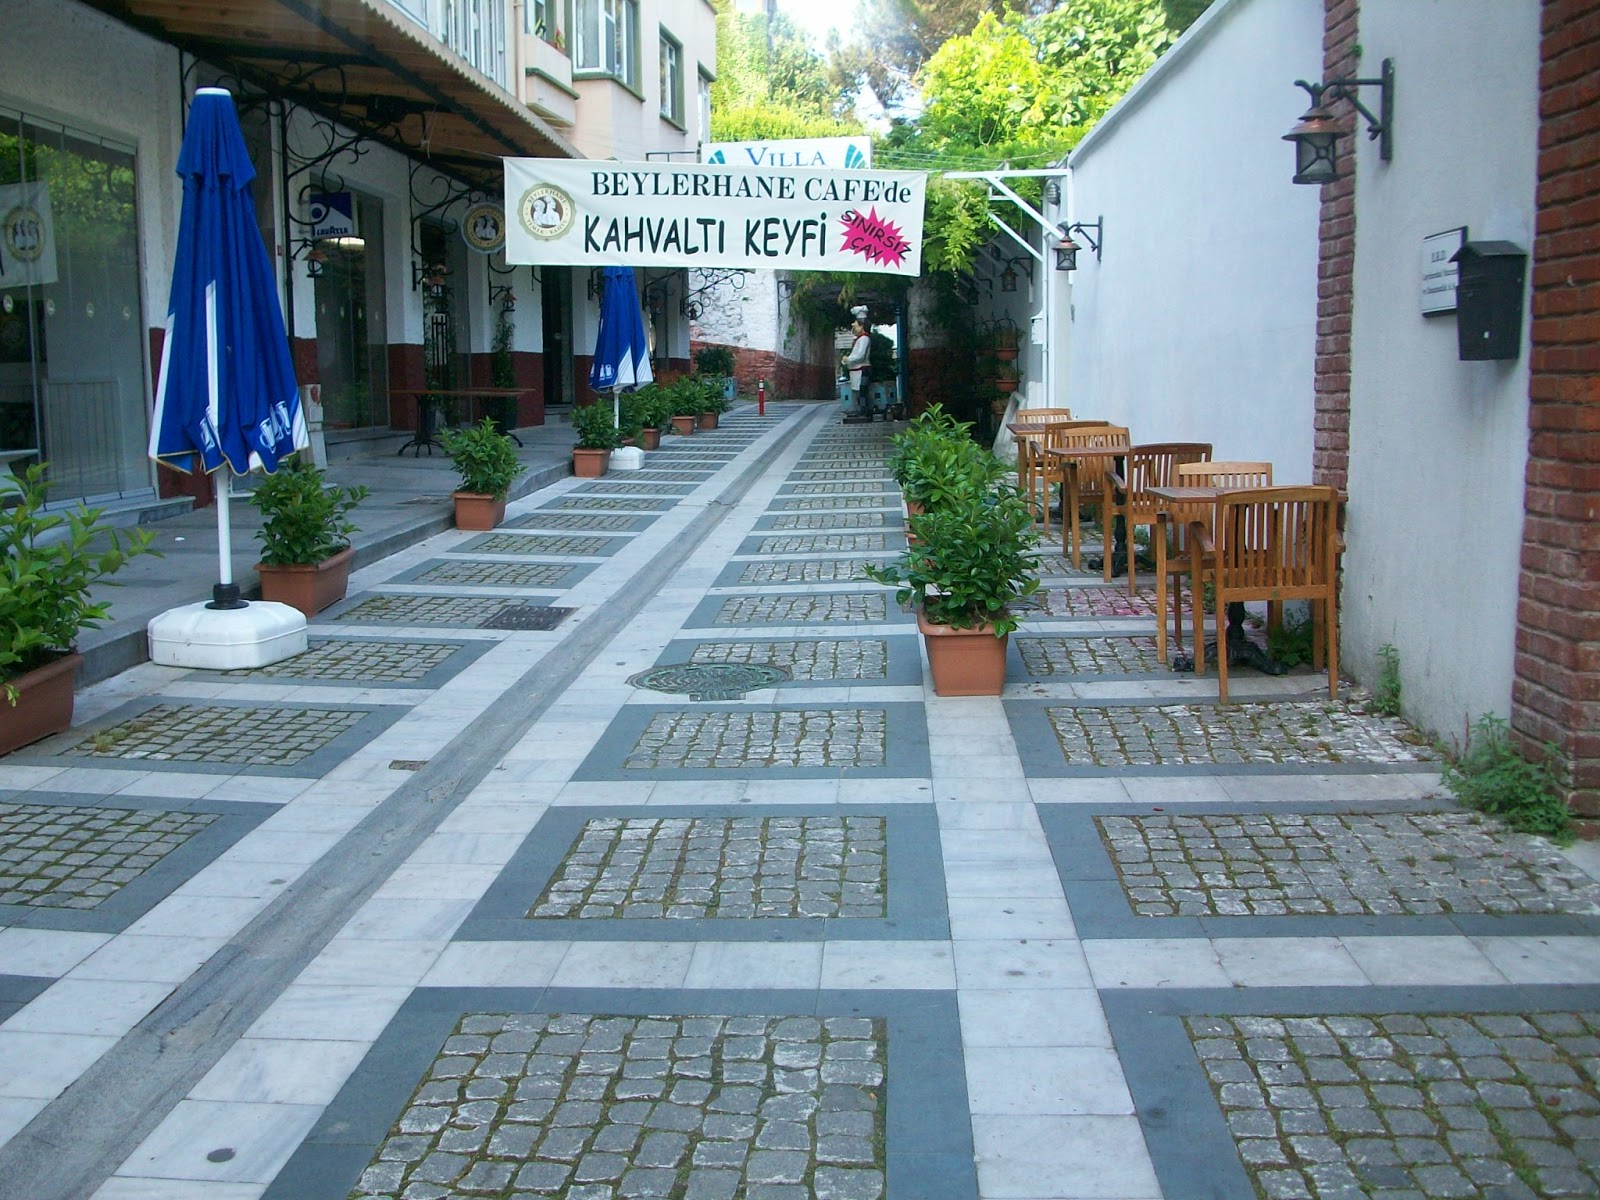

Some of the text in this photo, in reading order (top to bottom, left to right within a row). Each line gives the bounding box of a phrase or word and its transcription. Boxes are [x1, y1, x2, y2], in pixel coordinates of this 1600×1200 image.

[744, 146, 827, 167] VILLA
[591, 171, 912, 204] BEYLERHANE CAFE'de
[584, 211, 828, 258] KAHVALTI KEYFİ
[840, 209, 913, 261] SINIRSIZ
[849, 236, 884, 259] ÇAY
